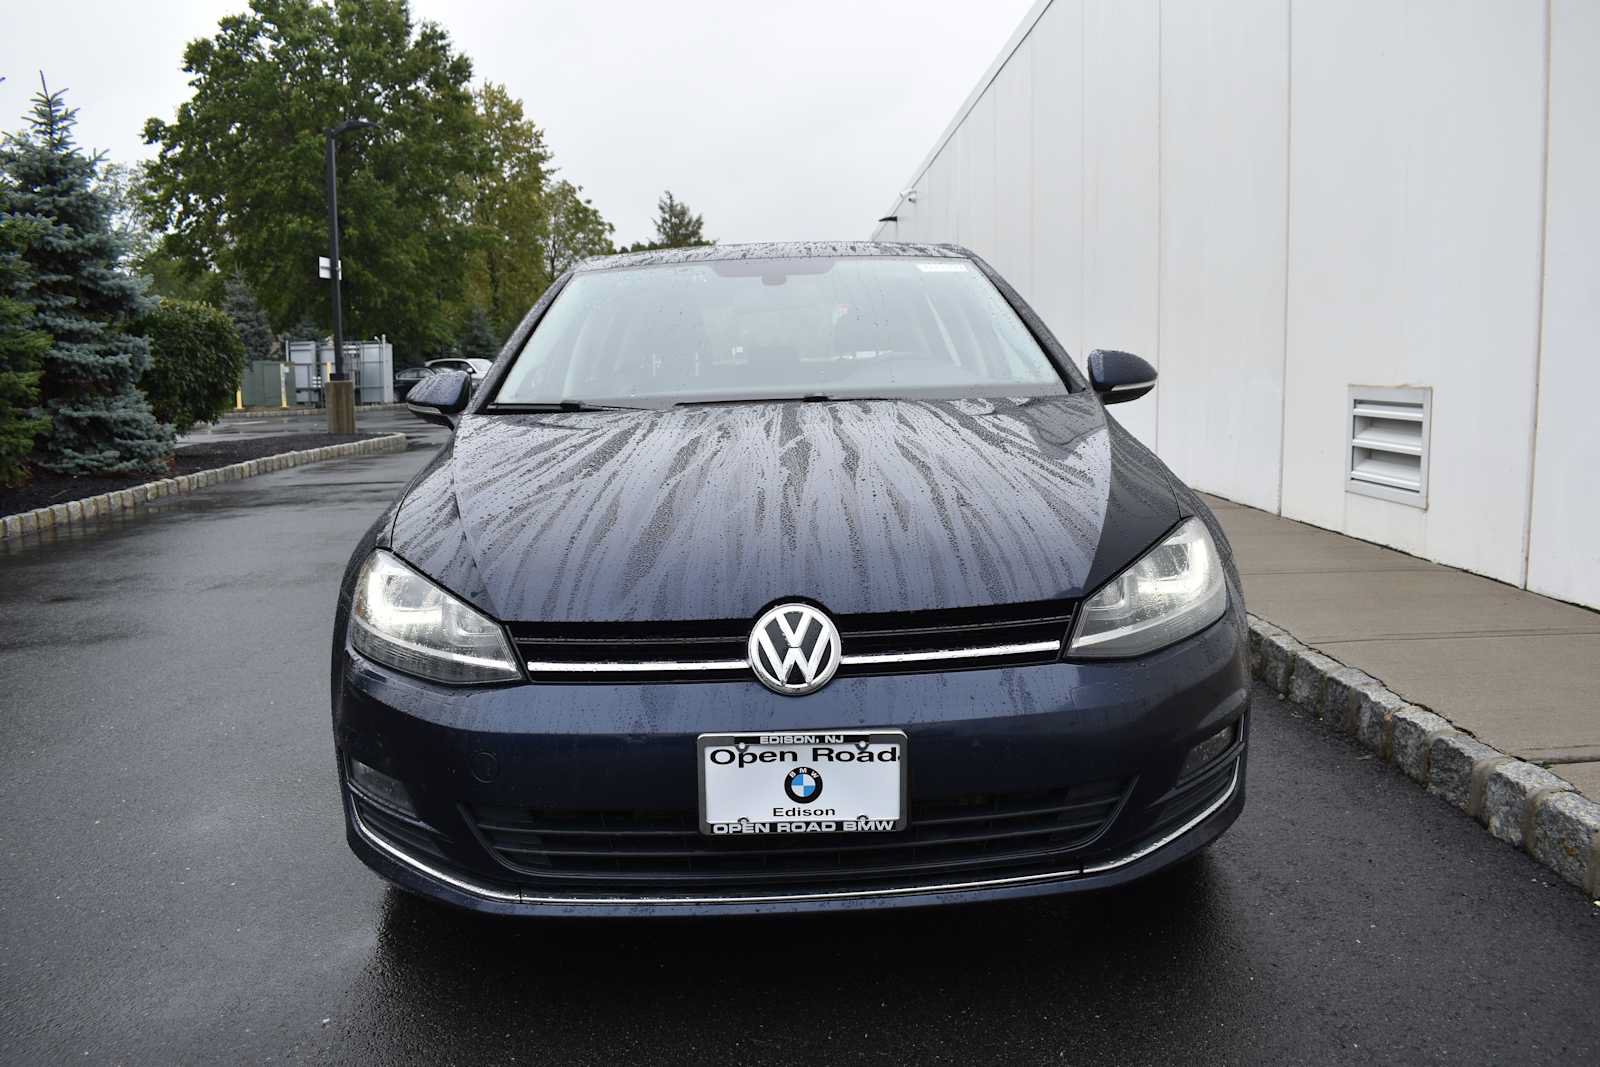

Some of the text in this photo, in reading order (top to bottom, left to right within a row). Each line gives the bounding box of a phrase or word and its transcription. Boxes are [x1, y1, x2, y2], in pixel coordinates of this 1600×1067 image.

[750, 605, 840, 693] VW
[760, 735, 844, 744] EDISON, NJ
[710, 747, 896, 768] Open Road
[789, 767, 819, 778] BMW
[773, 807, 835, 816] Edison
[713, 820, 894, 834] OPEN ROAD BMW
